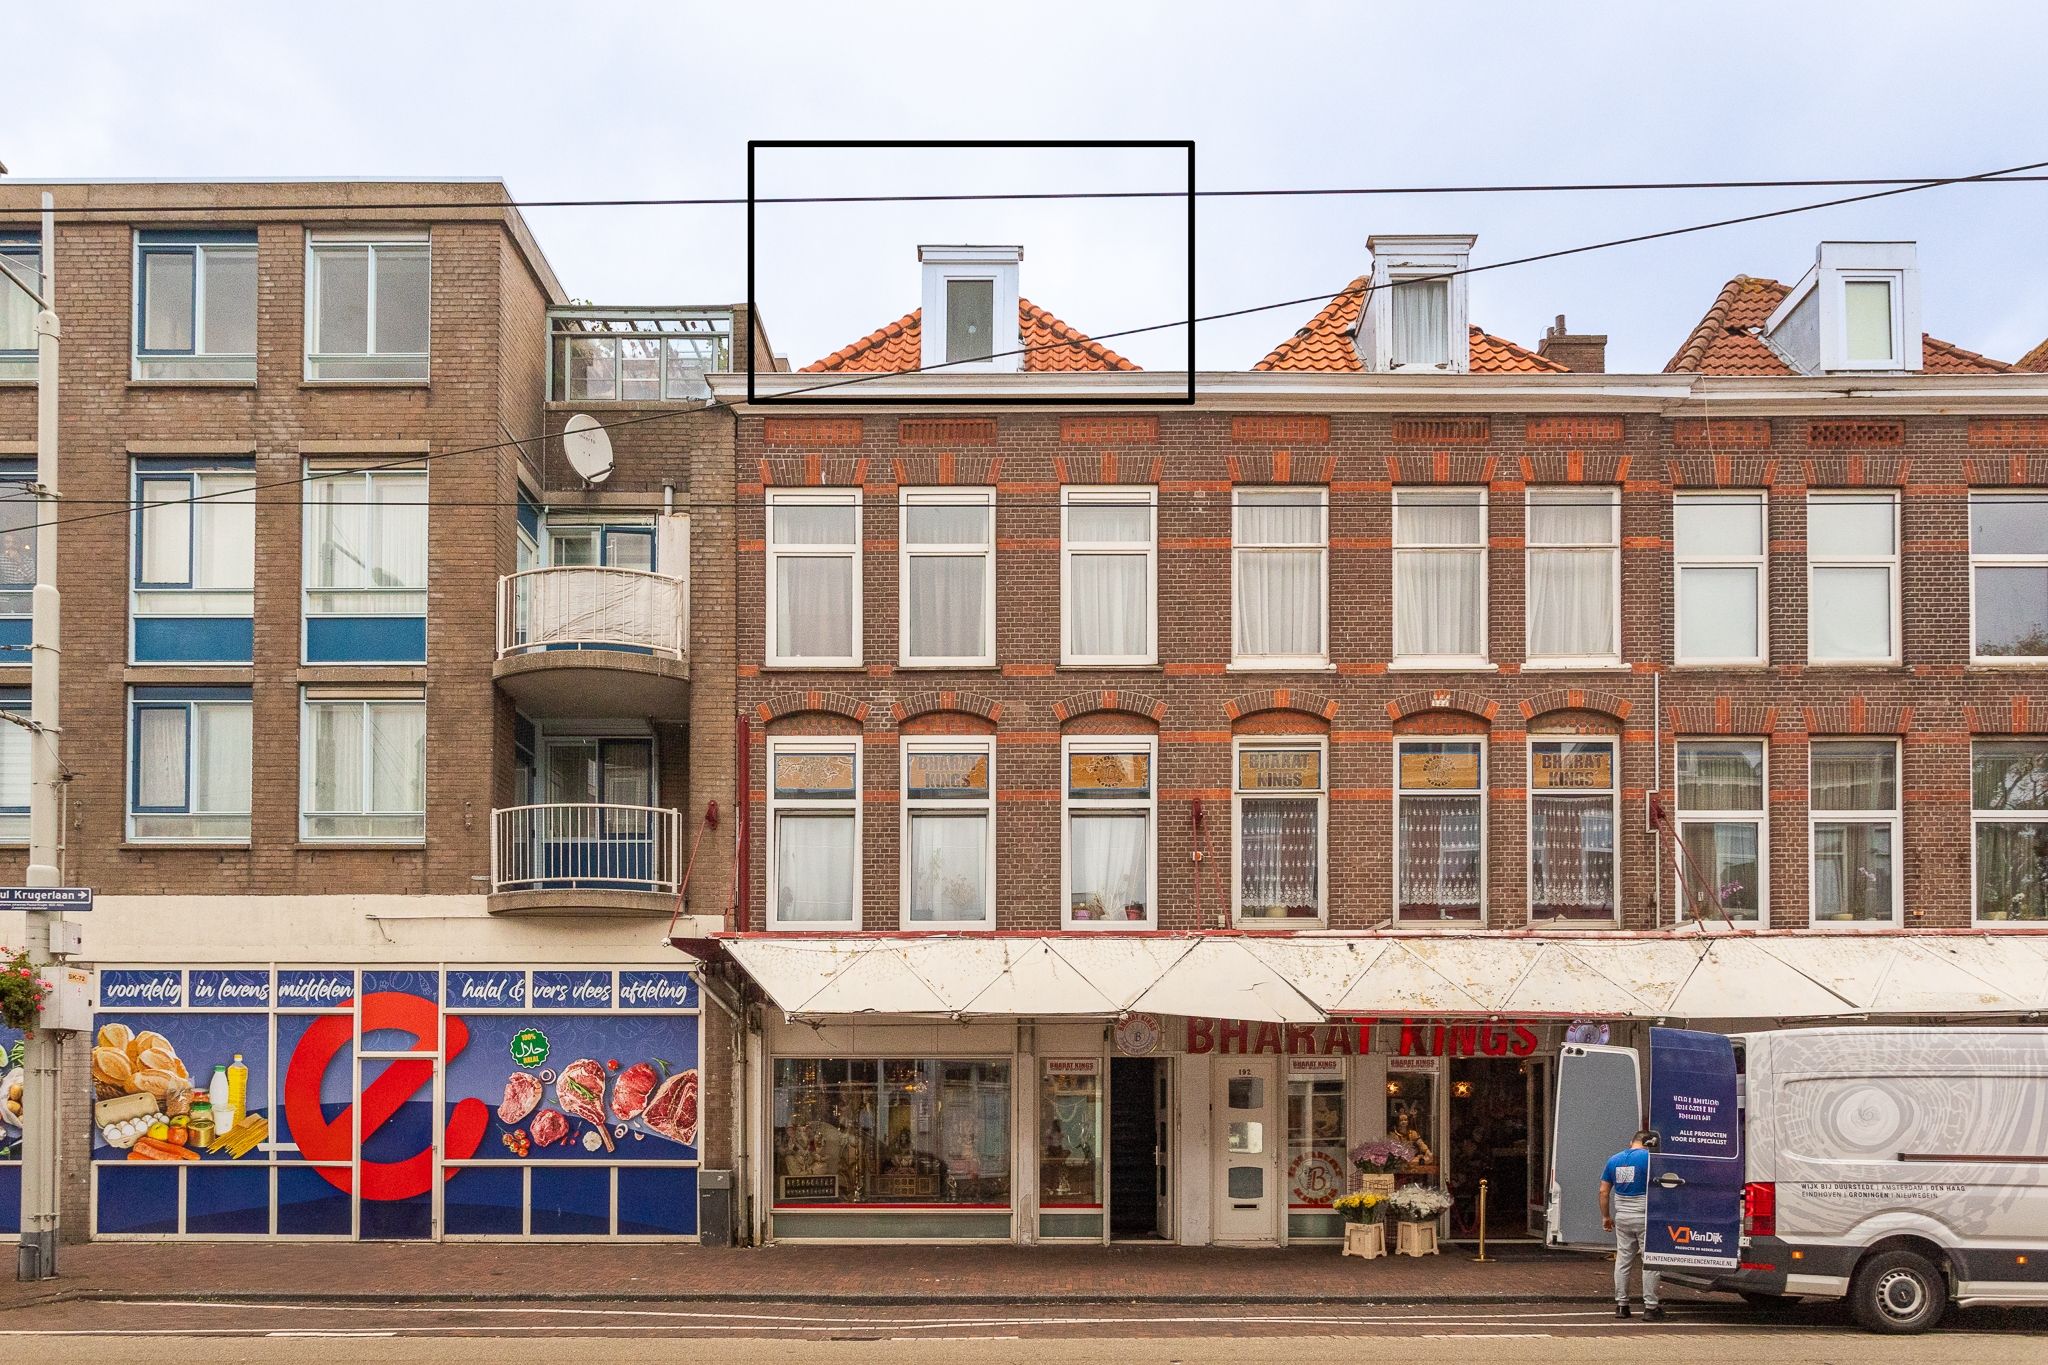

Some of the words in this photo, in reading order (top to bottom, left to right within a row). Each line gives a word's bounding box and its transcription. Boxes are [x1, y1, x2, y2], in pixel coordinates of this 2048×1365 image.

[1249, 753, 1309, 768] BHARAT
[1542, 754, 1603, 769] BHARAT
[925, 773, 970, 787] KINGS
[1257, 772, 1302, 787] KINGS
[1549, 772, 1594, 786] KINGS
[14, 890, 75, 902] Krugerlaan
[107, 978, 182, 1004] voordelig
[195, 979, 214, 997] in
[218, 978, 270, 1001] levens
[278, 978, 354, 1001] middelen
[462, 978, 507, 999] halal
[533, 984, 567, 1002] vers
[572, 979, 611, 1001] vlees
[620, 980, 688, 1005] afdeling
[1186, 1016, 1379, 1056] BHARAT
[1400, 1017, 1539, 1057] KINGS
[1694, 1130, 1727, 1139] PRODUCTEN
[1697, 1137, 1727, 1145] SPECIALIST
